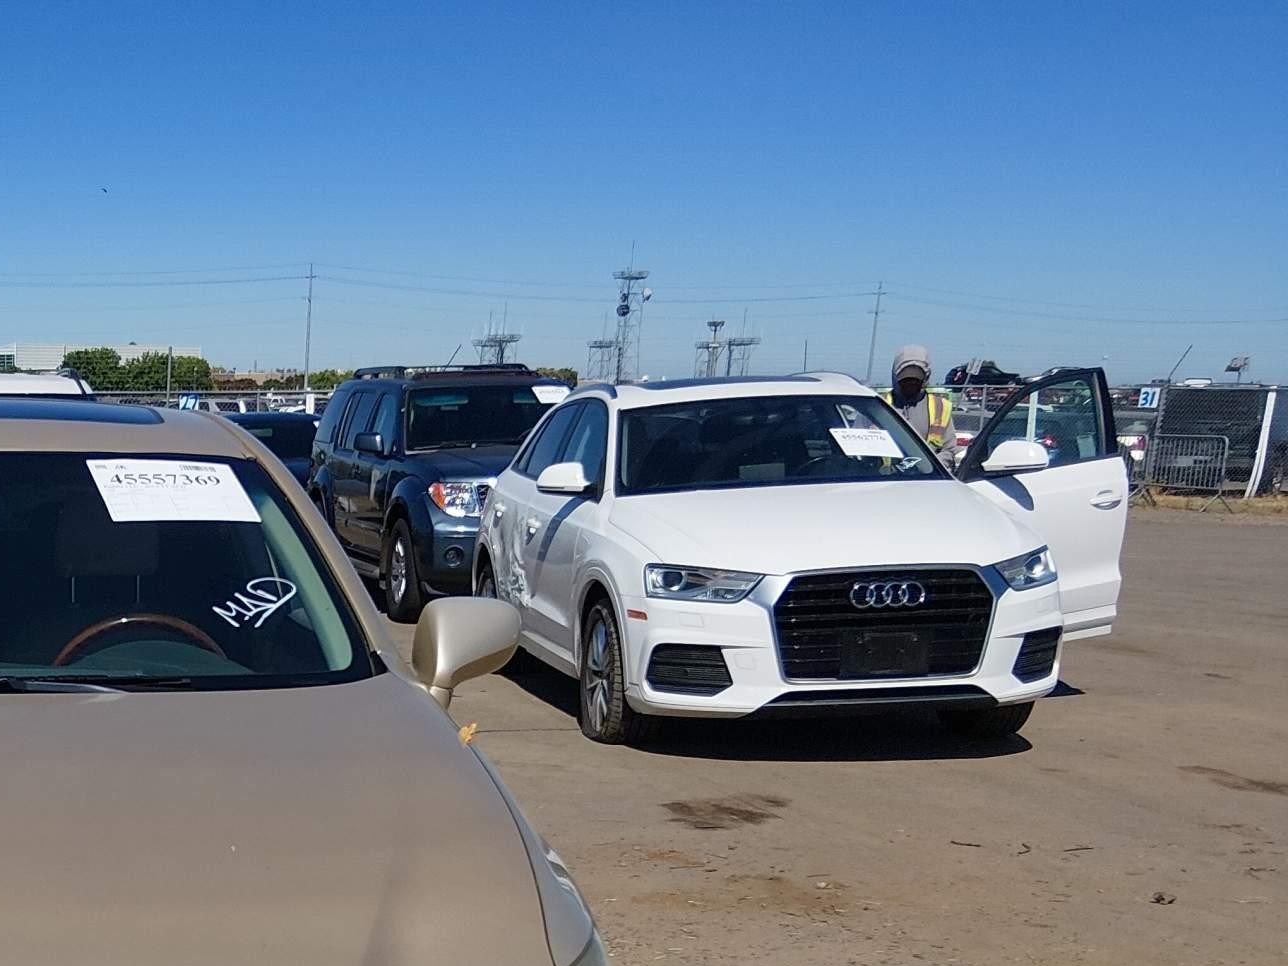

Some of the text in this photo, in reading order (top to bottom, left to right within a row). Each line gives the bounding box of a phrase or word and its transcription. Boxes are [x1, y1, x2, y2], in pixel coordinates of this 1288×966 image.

[180, 393, 199, 410] 27
[1140, 391, 1156, 406] 31
[110, 473, 221, 486] 45557369
